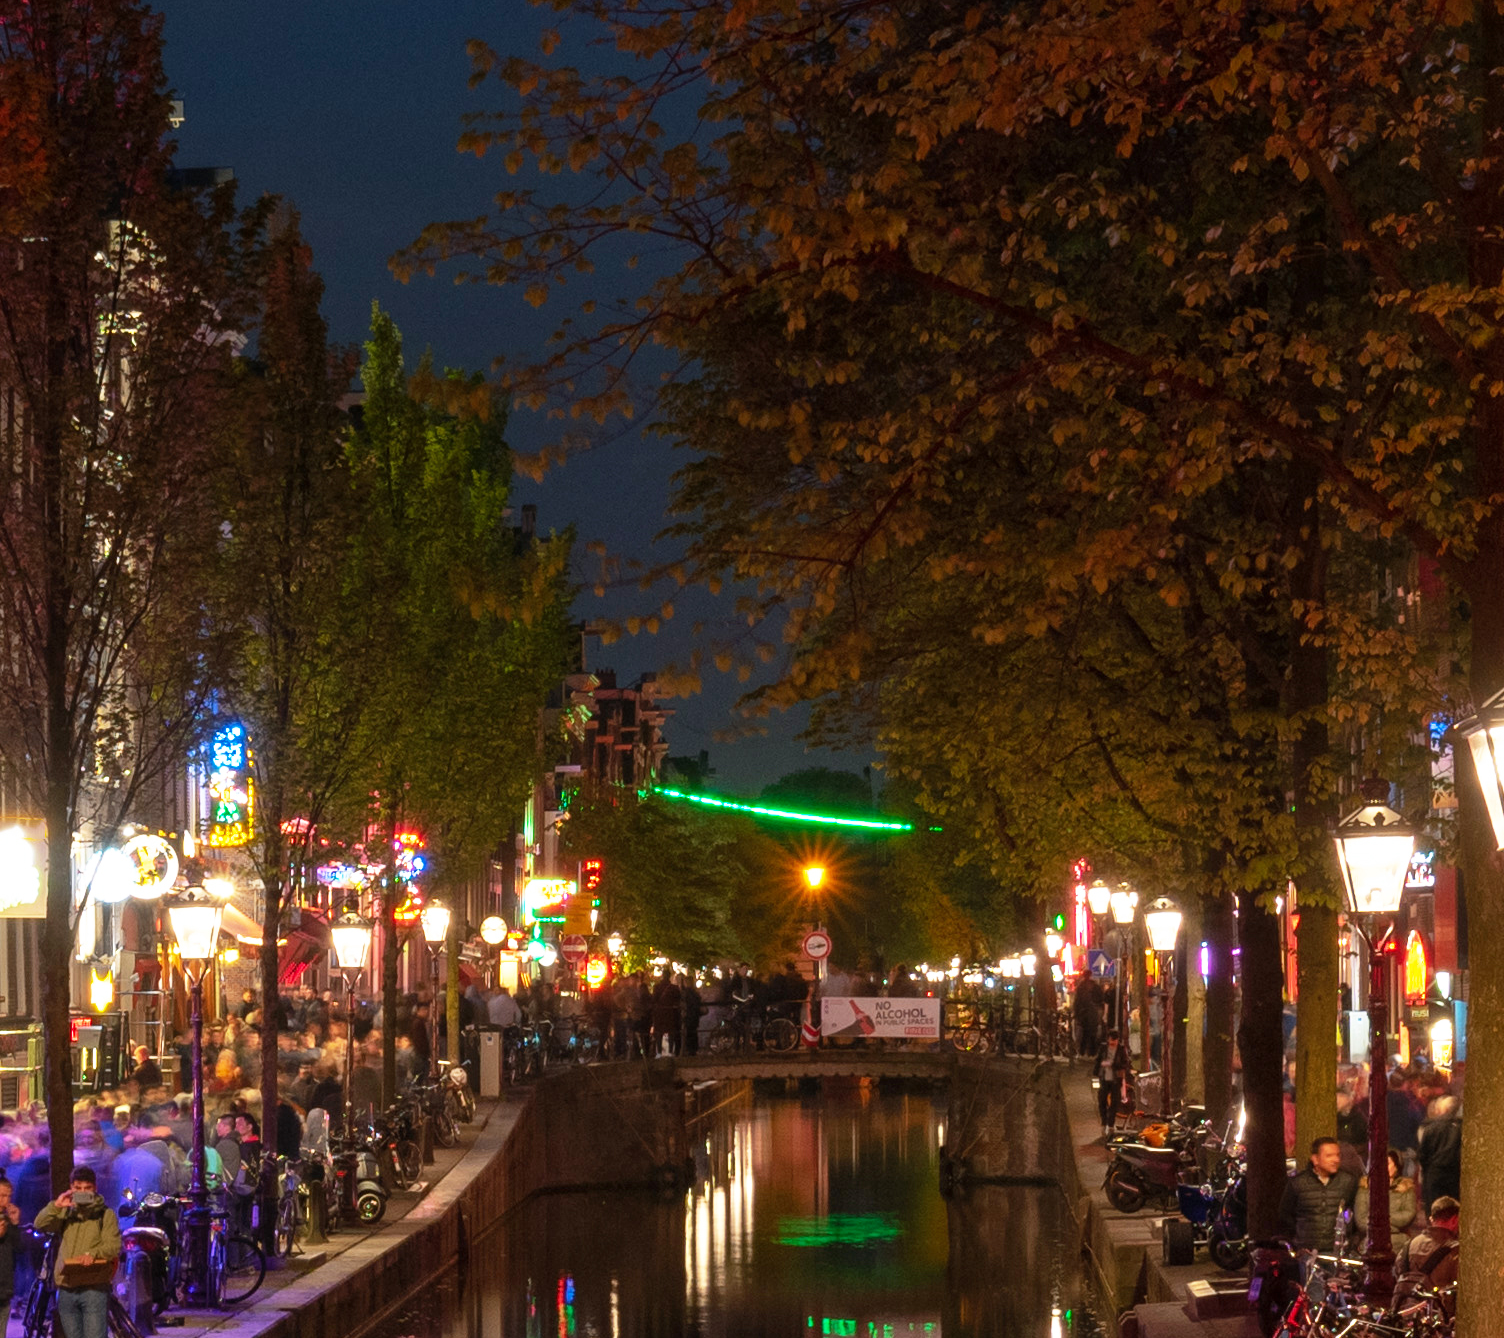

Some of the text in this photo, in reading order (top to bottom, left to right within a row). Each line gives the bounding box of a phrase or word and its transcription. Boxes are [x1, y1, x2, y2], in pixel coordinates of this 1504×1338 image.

[875, 1000, 892, 1011] NO
[875, 1008, 927, 1020] ALCOHOL
[883, 1018, 906, 1026] PUBLIC
[907, 1017, 934, 1025] SPACES
